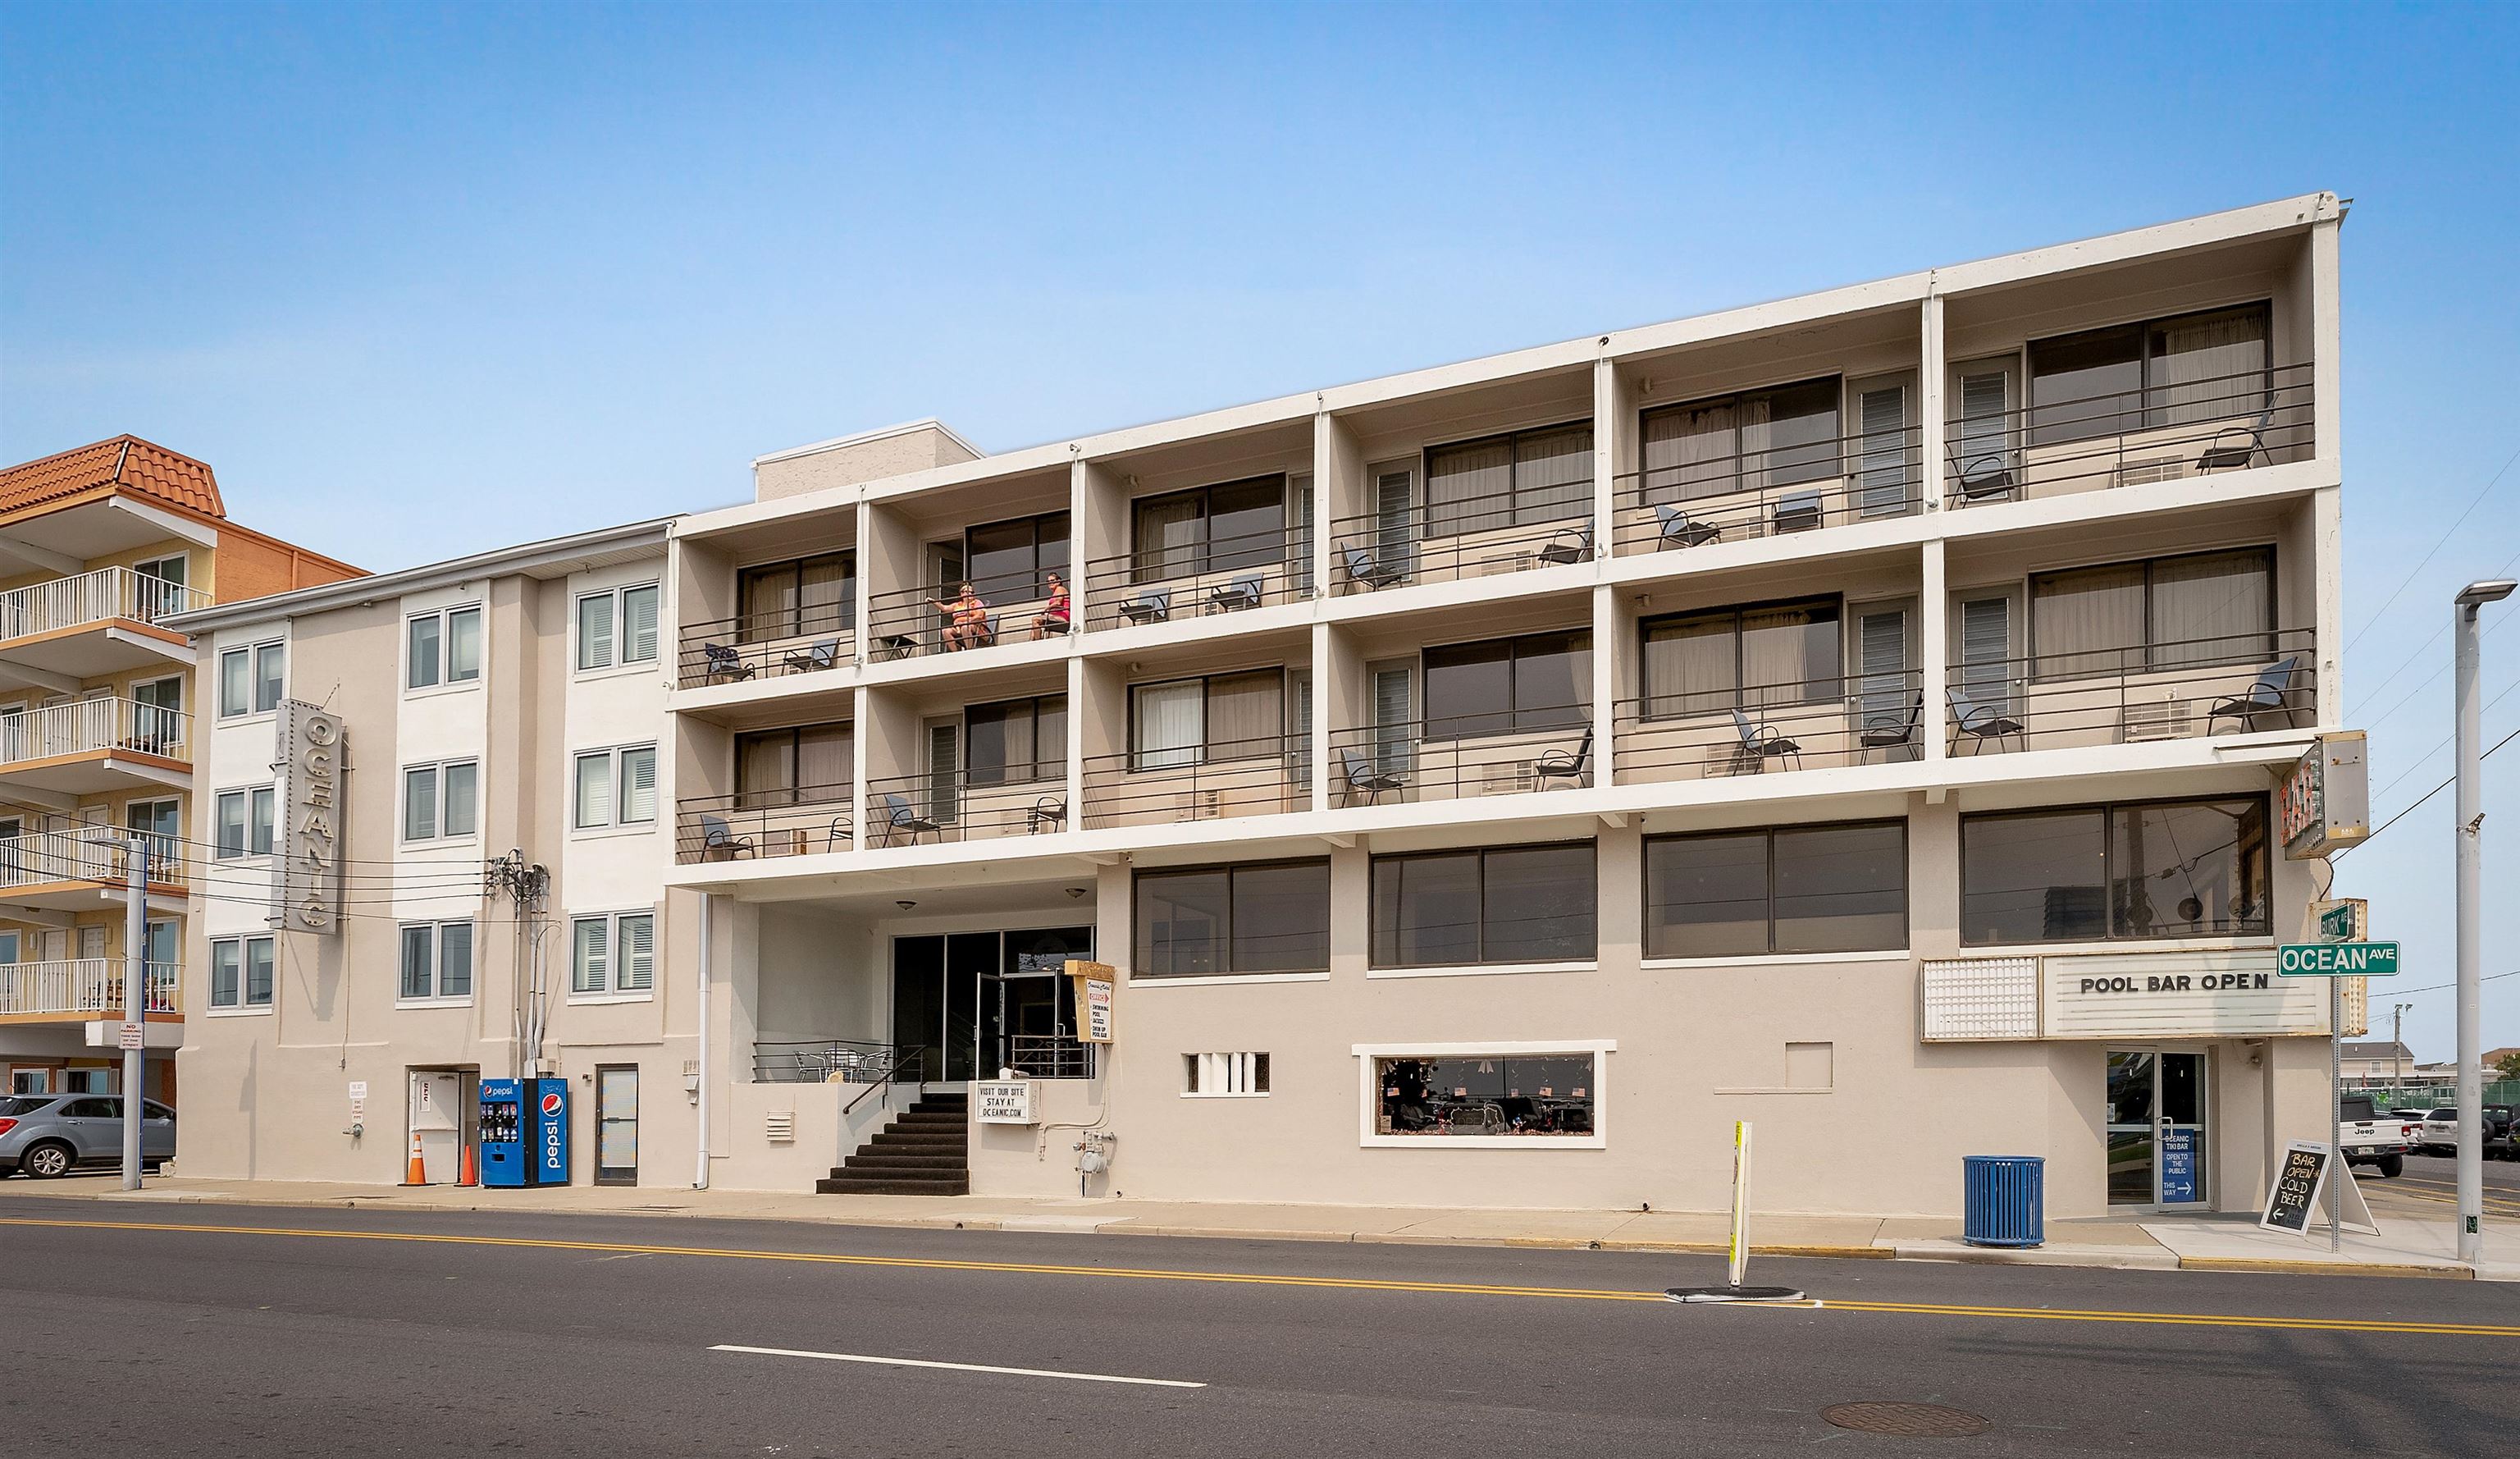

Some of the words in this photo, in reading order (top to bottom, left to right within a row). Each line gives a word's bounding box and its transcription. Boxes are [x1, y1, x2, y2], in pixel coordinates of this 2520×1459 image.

[298, 716, 336, 927] OCEANIC
[2322, 914, 2340, 939] BURK
[2282, 948, 2367, 971] OCEAN
[2369, 949, 2395, 960] AVE
[2081, 976, 2139, 993] POOL
[2148, 975, 2192, 991] BAR
[2201, 973, 2268, 990] OPEN
[493, 1087, 513, 1096] pepsi
[987, 1098, 1006, 1106] STAY
[1007, 1098, 1015, 1106] AT
[2291, 1153, 2316, 1167] BAR
[2287, 1167, 2314, 1178] OPEN
[2280, 1177, 2308, 1194] COLD
[2280, 1191, 2304, 1209] BEER
